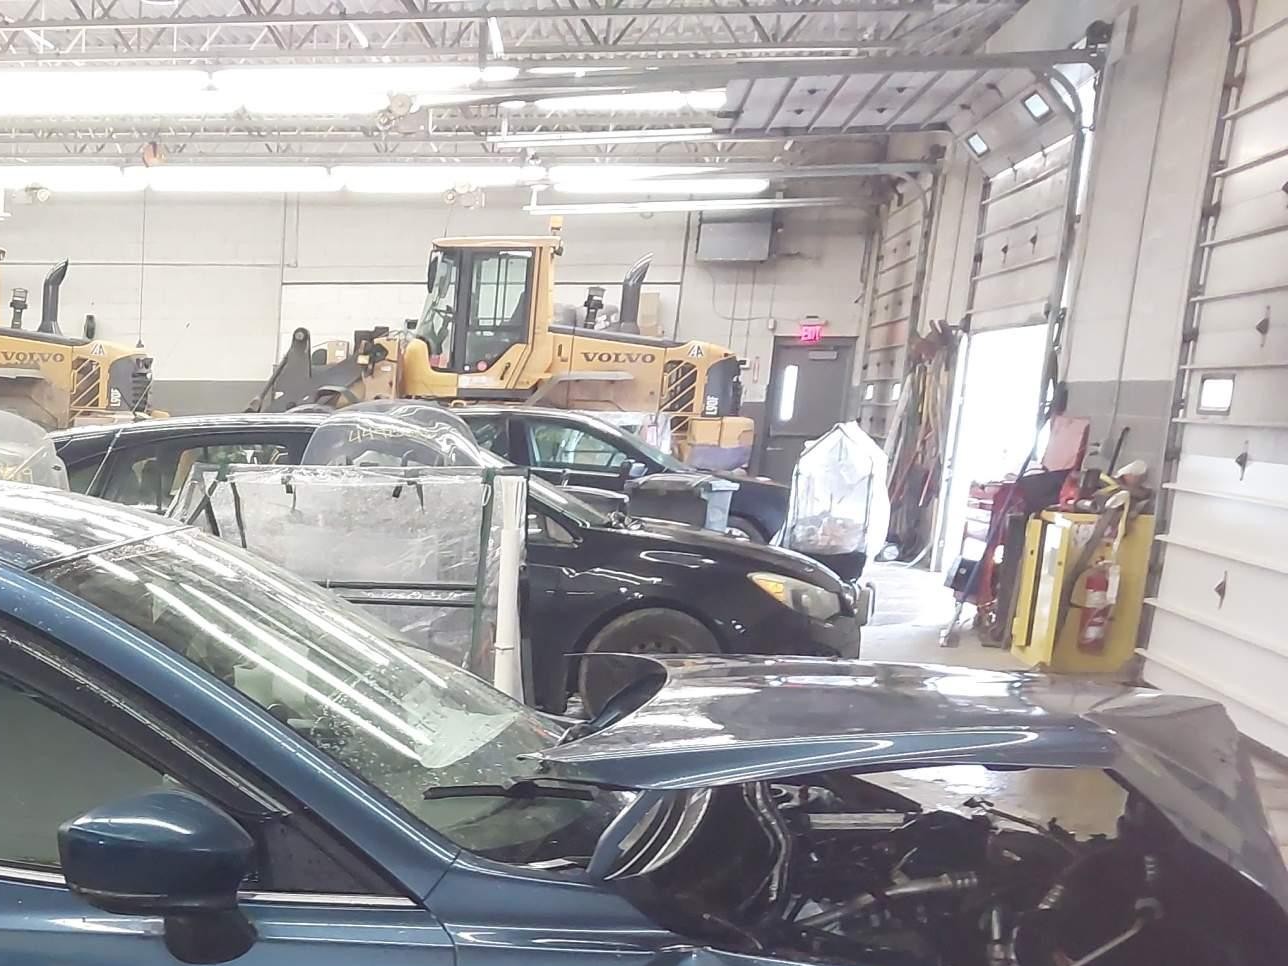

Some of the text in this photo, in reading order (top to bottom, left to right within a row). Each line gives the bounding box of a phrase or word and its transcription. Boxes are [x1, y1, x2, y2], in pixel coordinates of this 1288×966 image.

[0, 351, 65, 363] VOLVO
[581, 352, 656, 363] VOLVO
[705, 395, 719, 415] L90F
